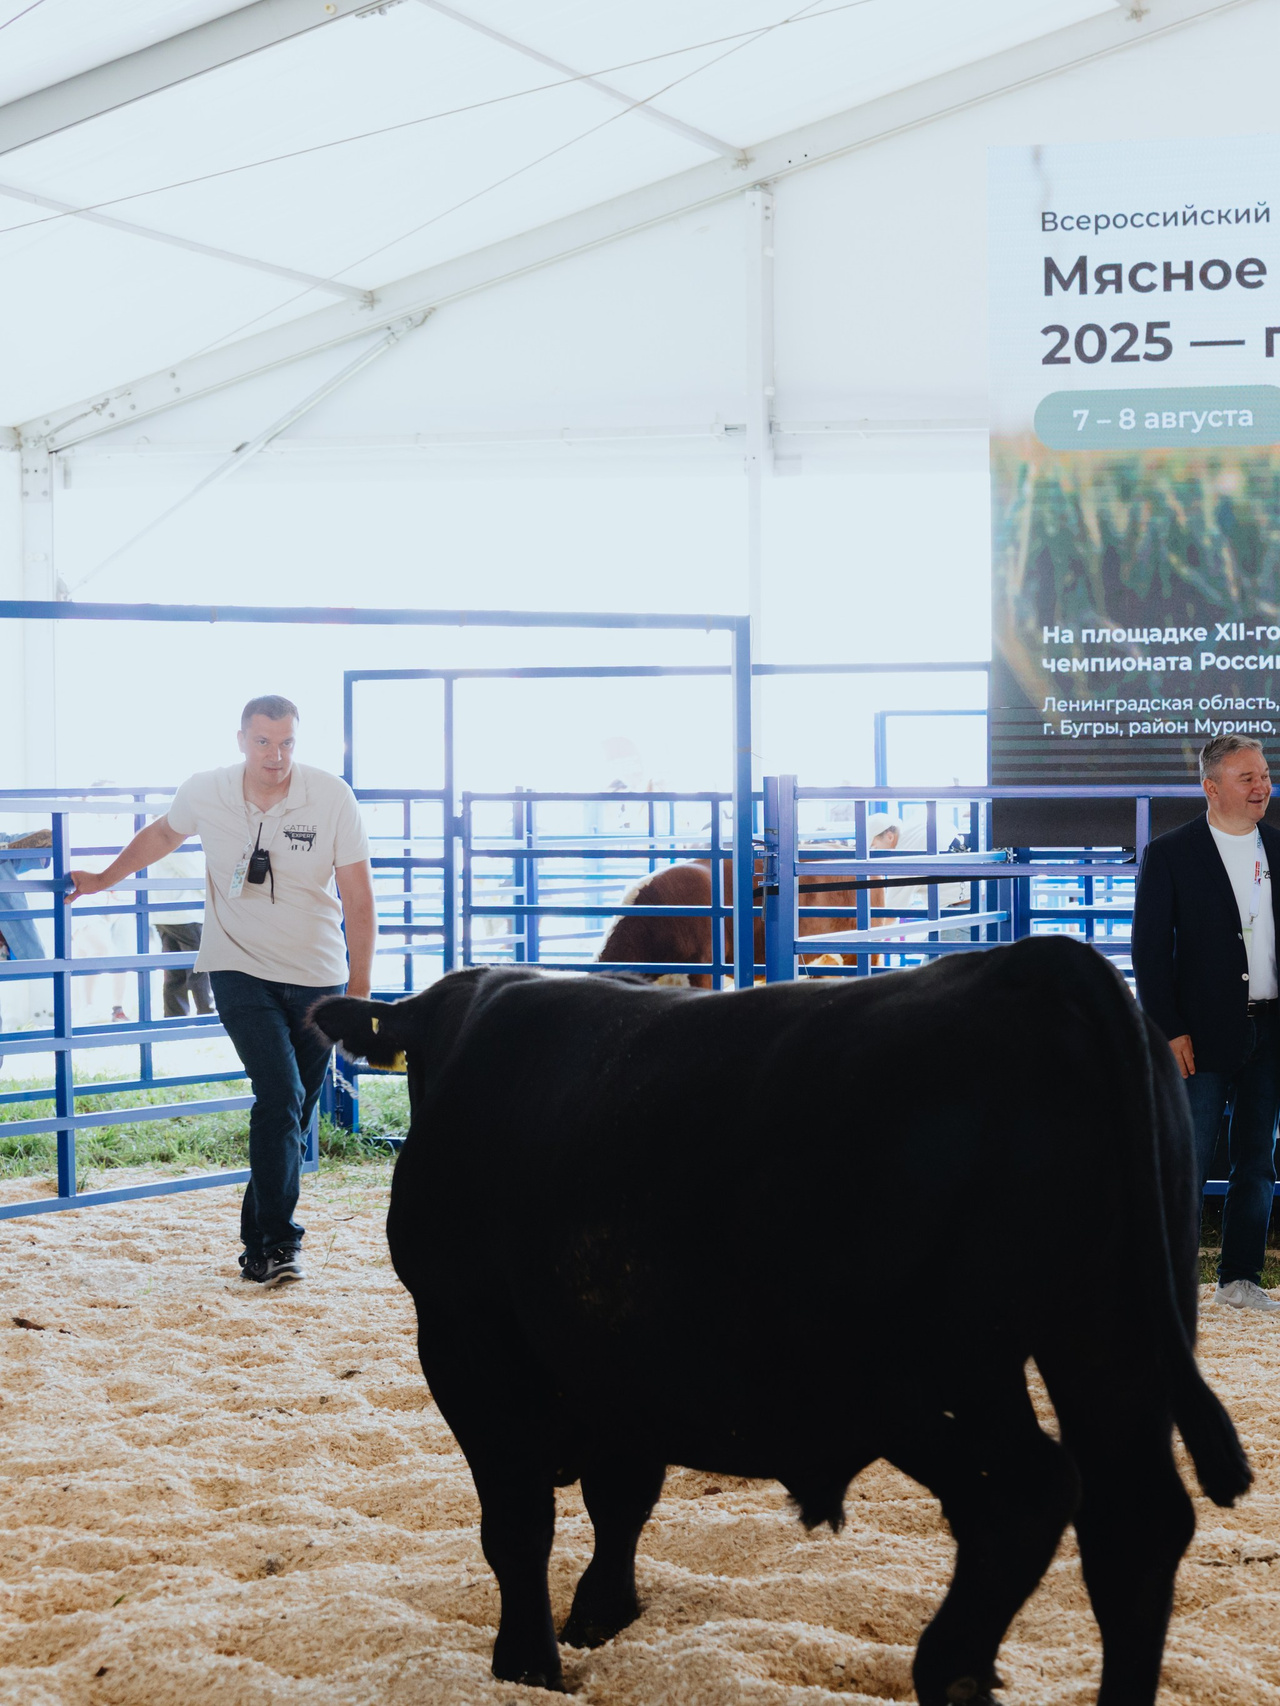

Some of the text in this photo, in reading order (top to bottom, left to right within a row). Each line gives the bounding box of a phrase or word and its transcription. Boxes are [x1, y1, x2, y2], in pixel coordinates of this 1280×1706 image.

[1041, 202, 1270, 235] Всероссийский
[1044, 256, 1267, 296] Мясное
[1040, 321, 1173, 365] 2025
[1073, 409, 1089, 431] 7
[1118, 408, 1136, 430] 8
[1144, 410, 1253, 434] августа
[1042, 626, 1074, 644] На
[1081, 624, 1207, 646] площадке
[1042, 656, 1192, 673] чемпионата
[1042, 696, 1193, 715] Ленинградская
[1198, 694, 1280, 712] область,
[1043, 723, 1054, 735] г.
[1060, 719, 1124, 739] Бугры,
[1129, 716, 1189, 738] район
[1194, 717, 1277, 738] Мурино,
[283, 824, 317, 832] CATTLE
